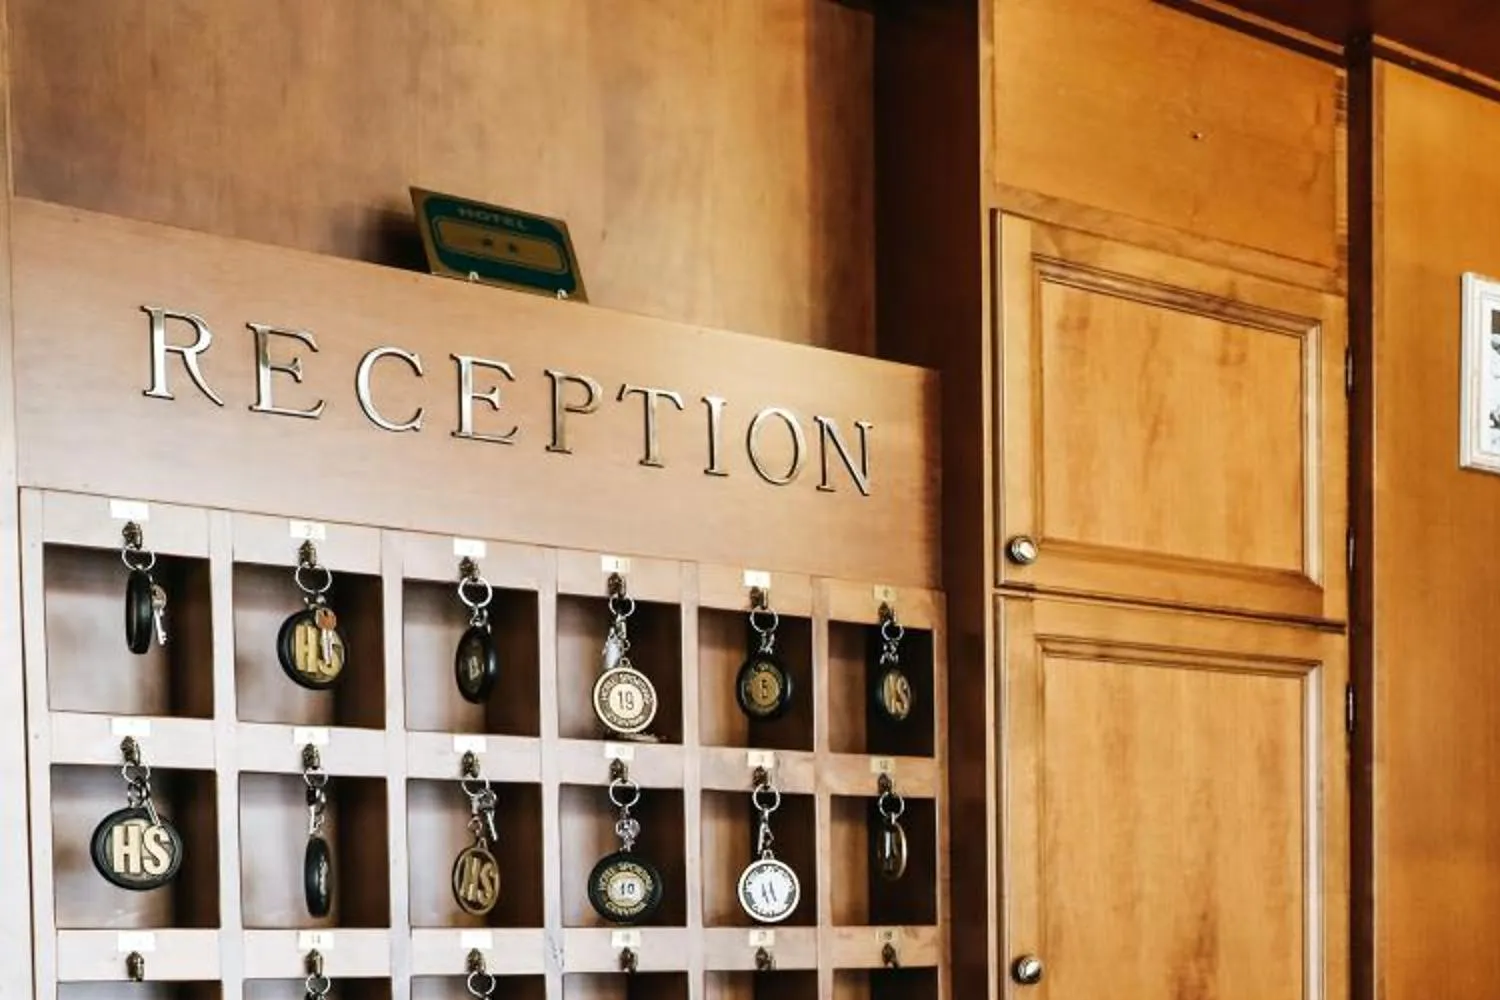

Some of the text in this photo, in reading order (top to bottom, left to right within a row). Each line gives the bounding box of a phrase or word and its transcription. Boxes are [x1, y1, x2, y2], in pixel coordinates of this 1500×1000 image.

[457, 207, 530, 231] HOTEL
[140, 303, 873, 498] RECEPTION
[112, 823, 172, 876] HS
